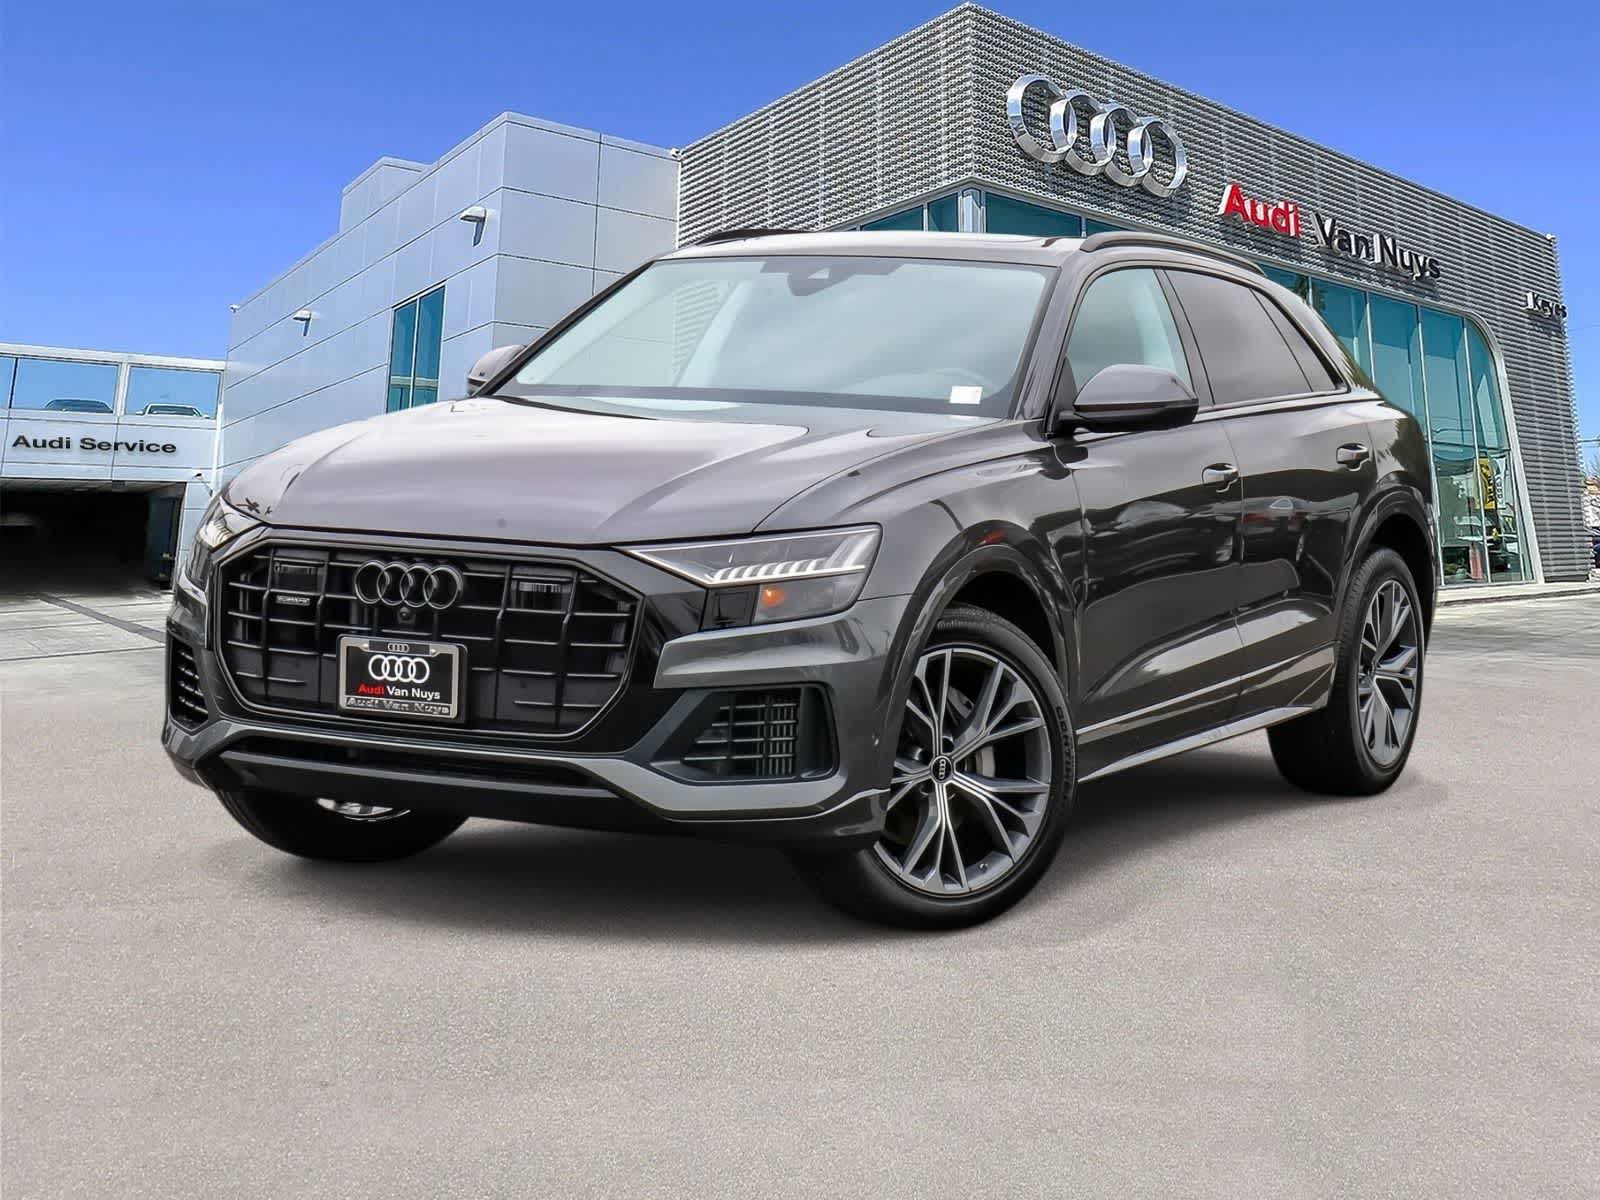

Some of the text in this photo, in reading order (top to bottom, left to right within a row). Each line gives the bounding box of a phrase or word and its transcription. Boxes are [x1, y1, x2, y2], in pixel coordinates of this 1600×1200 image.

[1218, 182, 1441, 280] Audi Van Nuys
[1526, 292, 1567, 318] Keyes
[12, 435, 177, 453] Audi Service
[358, 684, 441, 701] Audi Van Nuys
[347, 697, 450, 715] Audi Van Nuys
